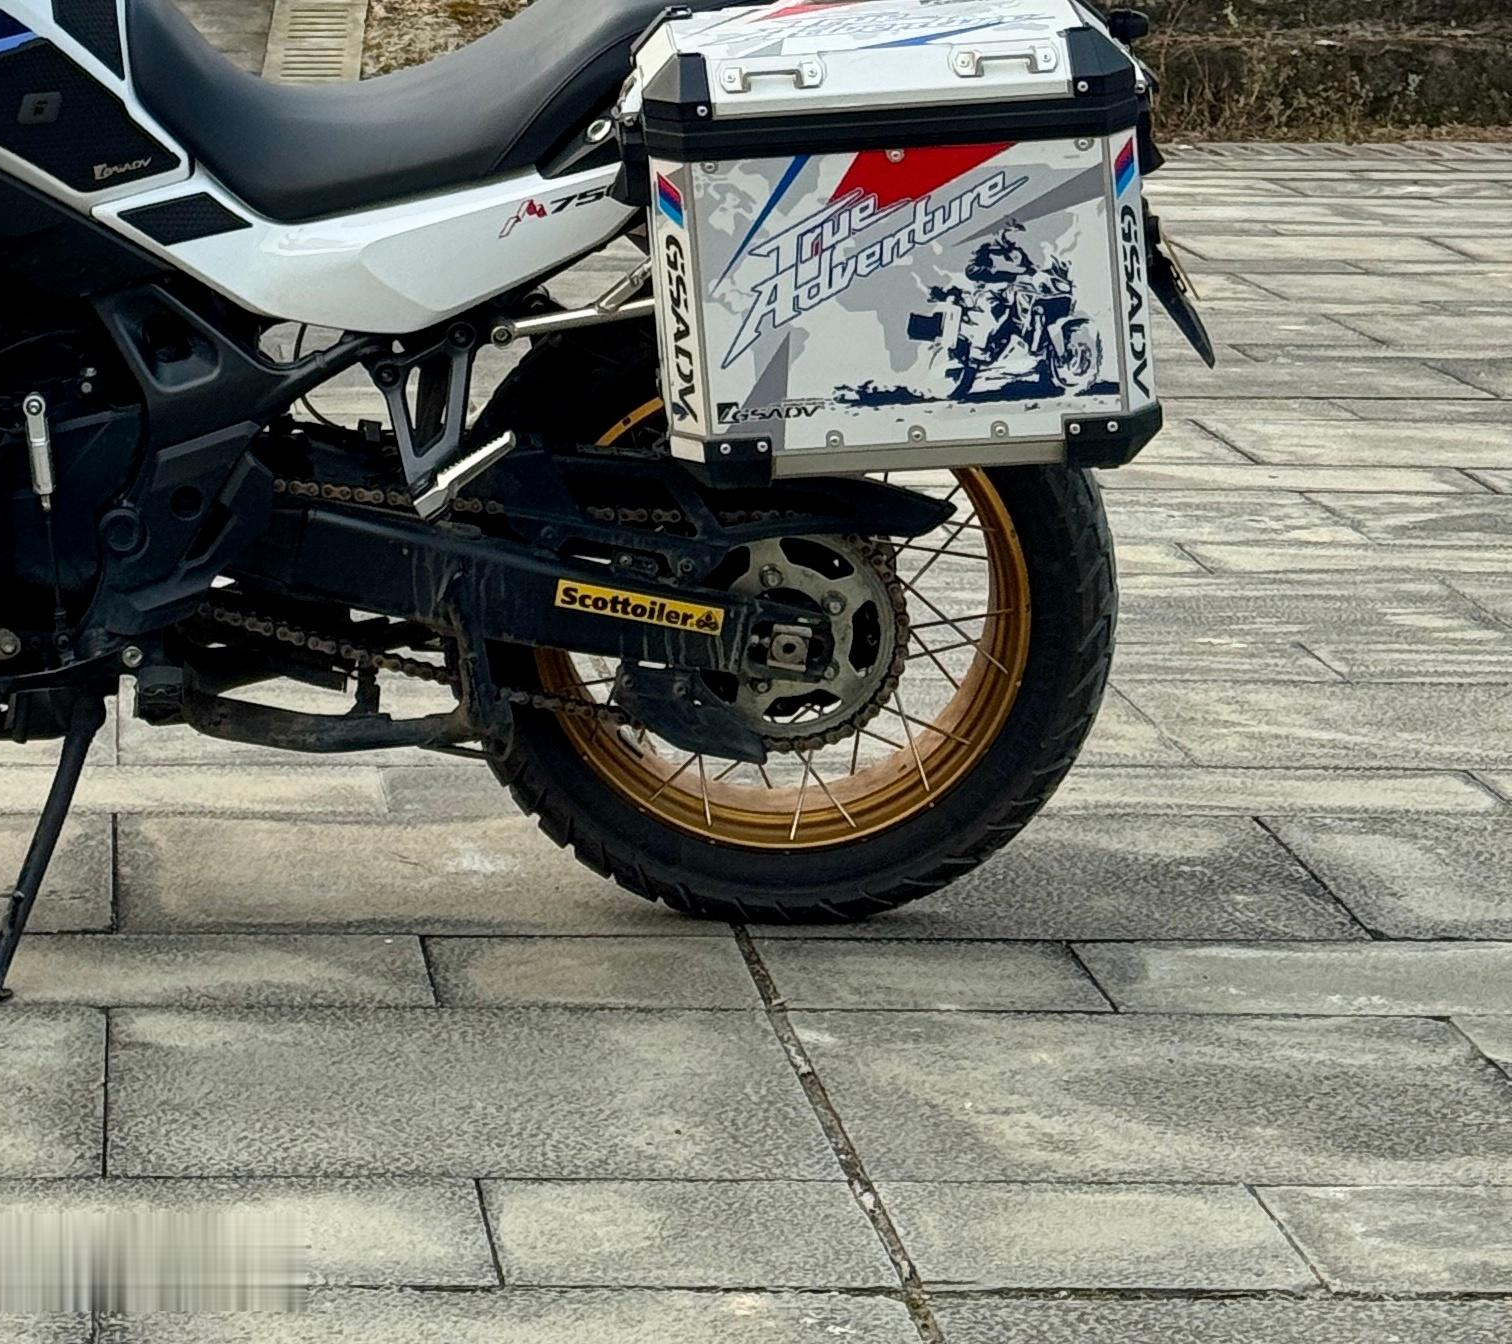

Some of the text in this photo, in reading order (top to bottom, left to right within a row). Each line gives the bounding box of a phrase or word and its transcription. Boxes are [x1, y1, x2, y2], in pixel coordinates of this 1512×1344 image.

[665, 233, 698, 424] GSADV
[721, 171, 1029, 369] Adventure
[748, 188, 910, 278] True
[1120, 203, 1151, 400] GSADV
[560, 586, 694, 627] Scottoiler
